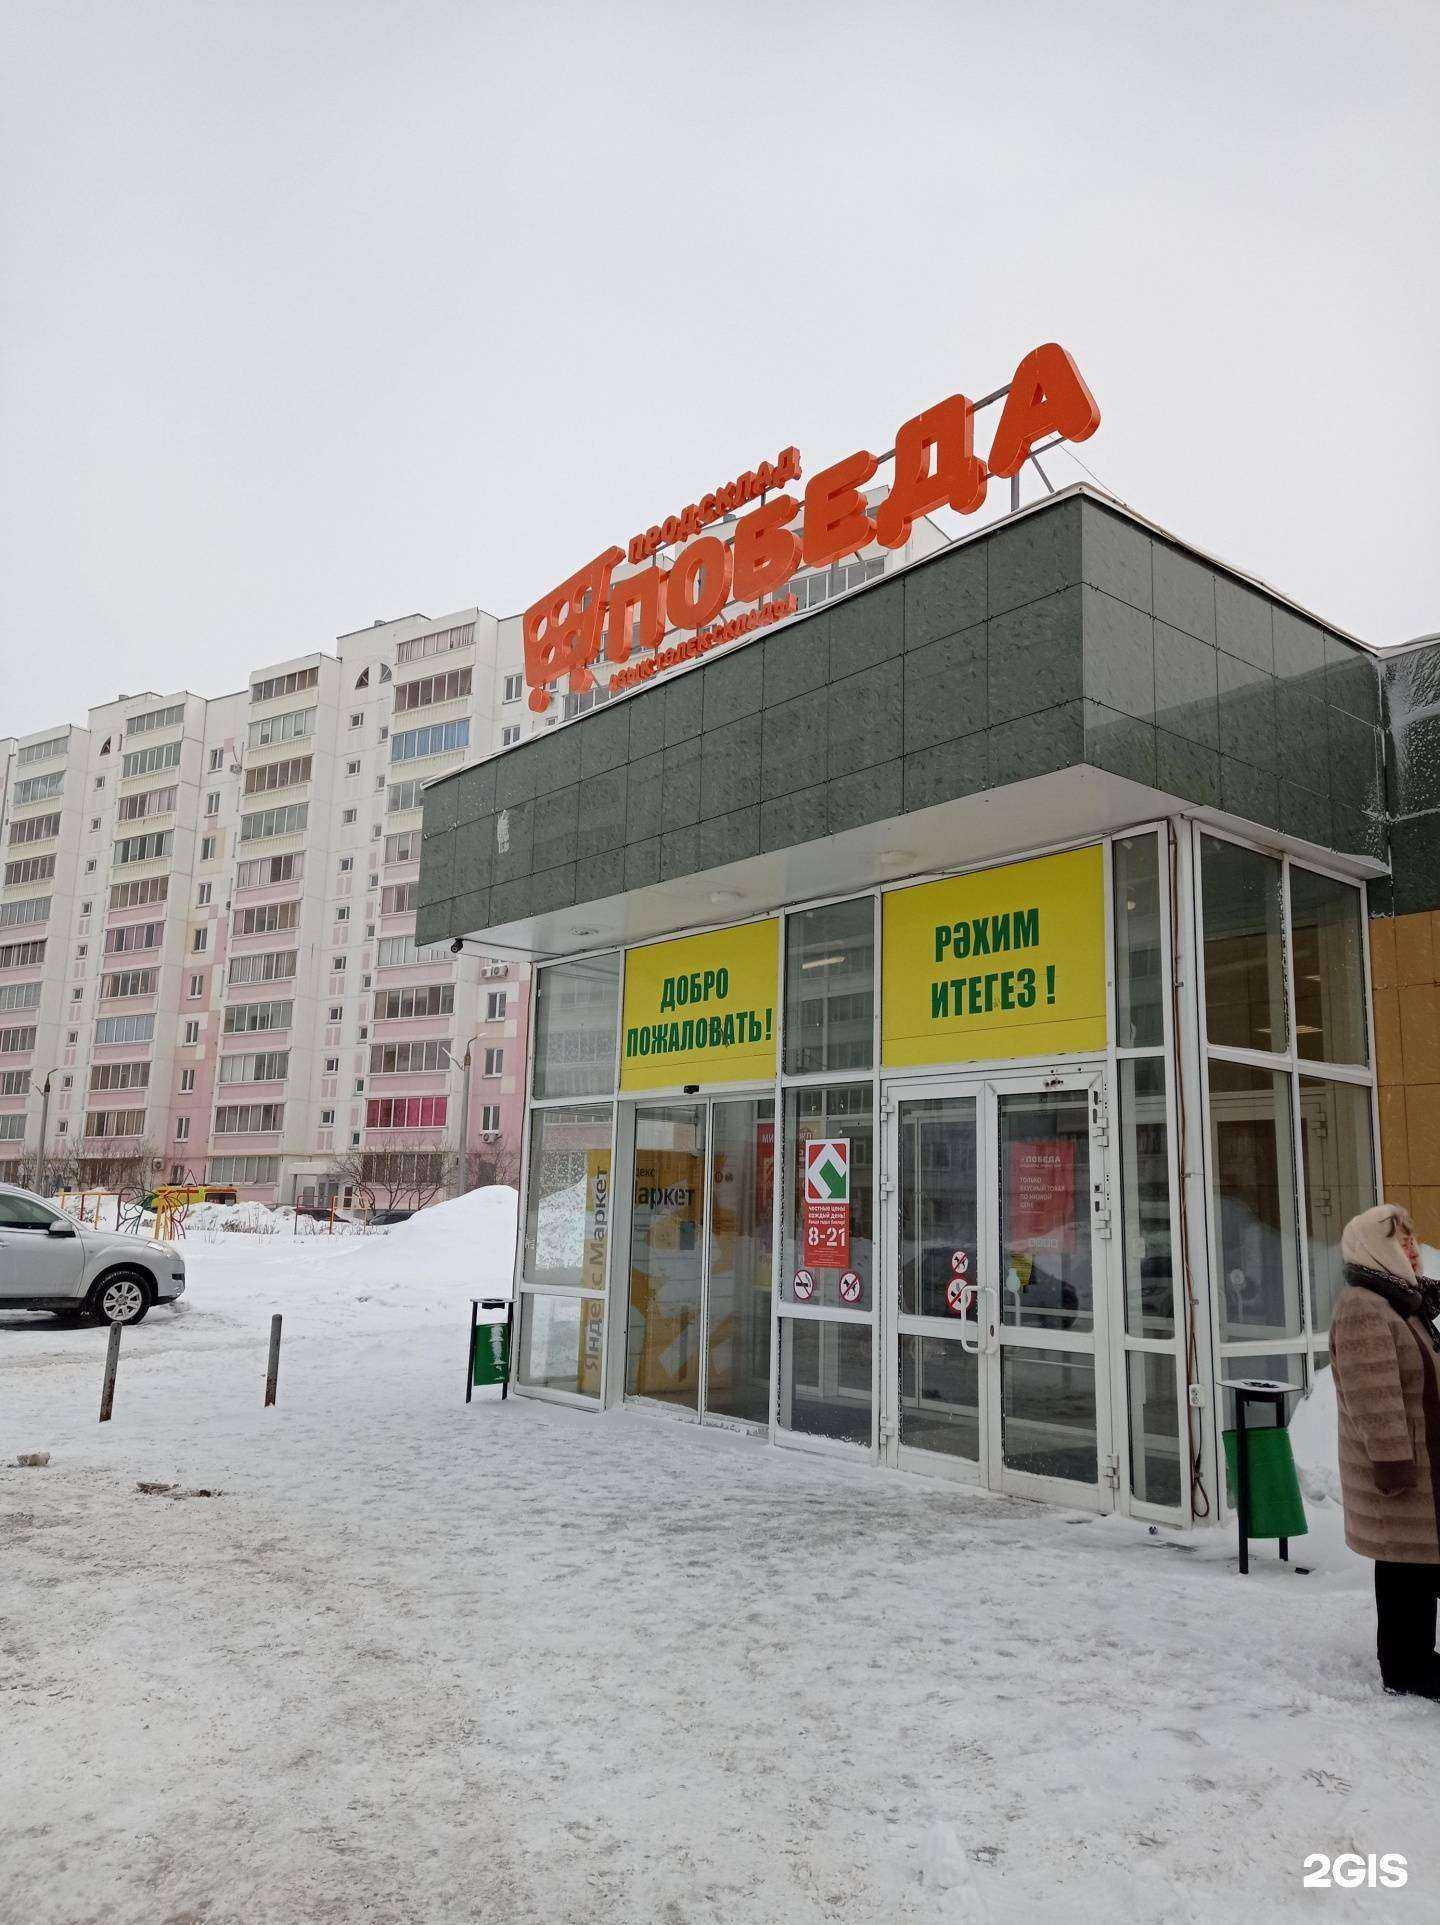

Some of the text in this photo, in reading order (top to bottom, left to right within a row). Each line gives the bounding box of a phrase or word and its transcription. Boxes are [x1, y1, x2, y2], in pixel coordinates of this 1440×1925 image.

[603, 342, 1100, 664] ПОБЕДА
[628, 446, 802, 565] ПРОДСКЛАД
[935, 907, 1040, 963] РӘХИМ
[660, 967, 729, 1013] ДОБРО
[626, 1008, 773, 1058] ПОЖАЛОВАТЬ!
[588, 1166, 608, 1266] Маркет
[634, 1180, 696, 1210] аркет
[808, 1226, 846, 1247] 8-21
